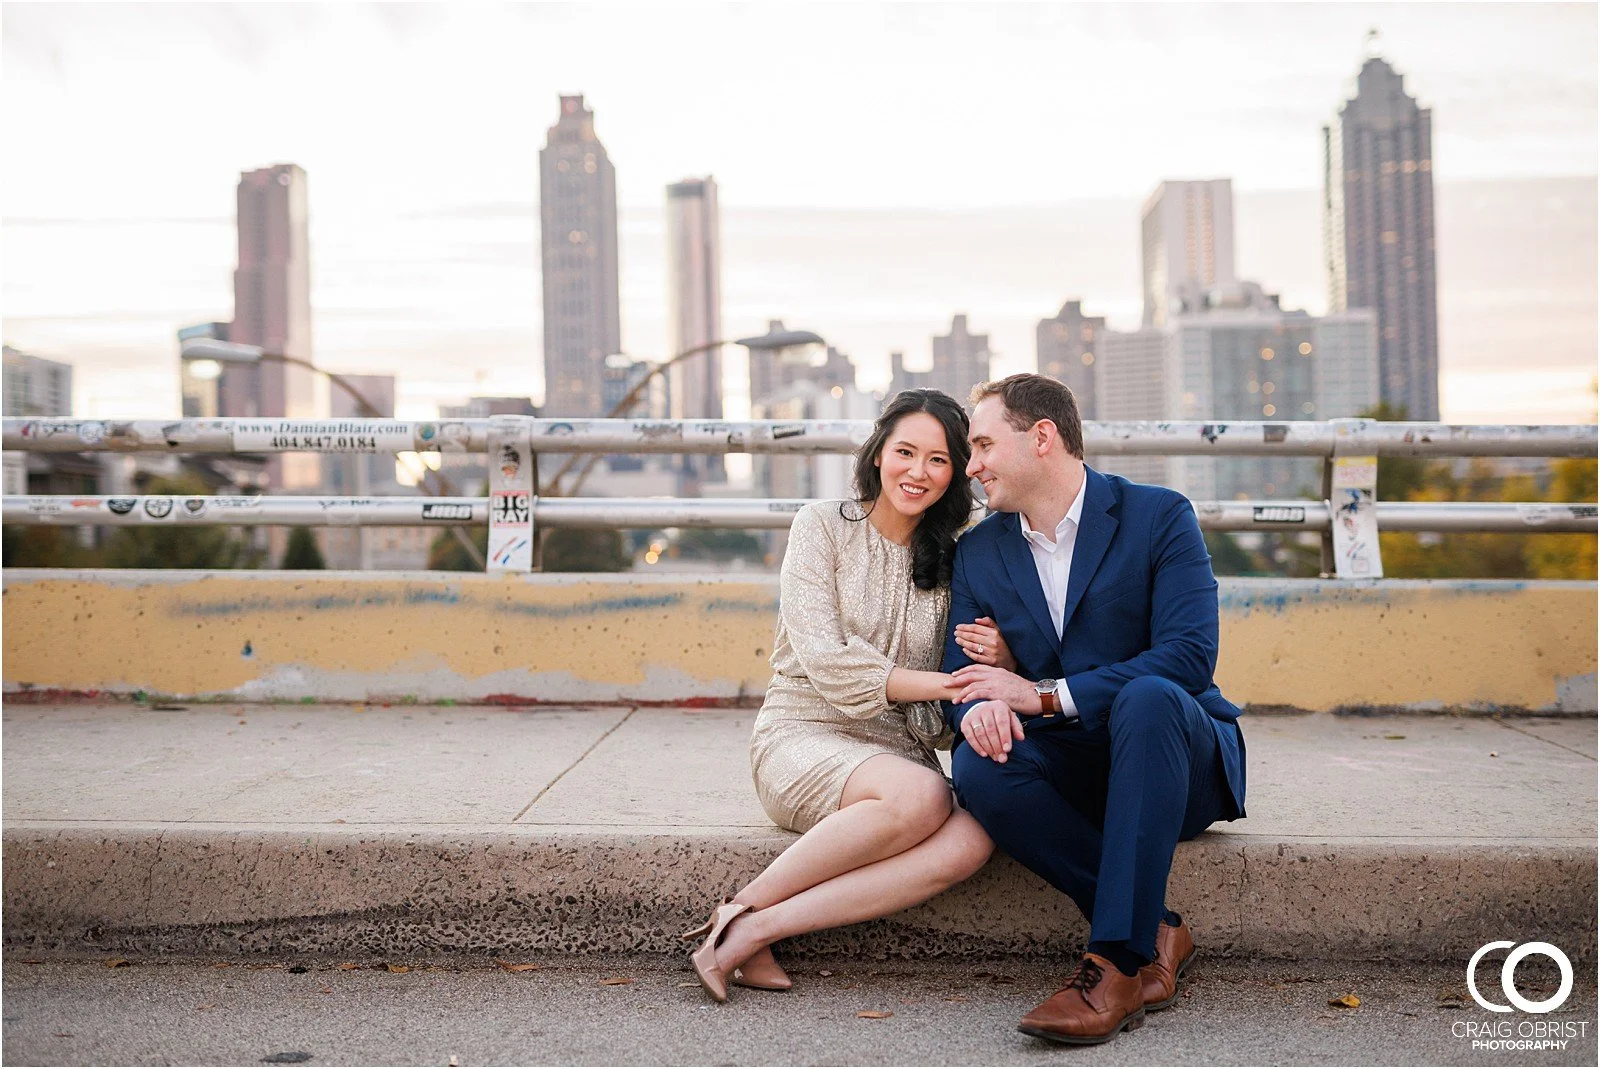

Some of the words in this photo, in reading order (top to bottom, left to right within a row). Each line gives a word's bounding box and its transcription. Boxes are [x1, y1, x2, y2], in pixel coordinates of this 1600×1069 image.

[238, 422, 408, 434] www.DamianBlair.com
[269, 436, 376, 448] 404.847.0184
[493, 496, 528, 508] BIG
[493, 509, 528, 522] RAY
